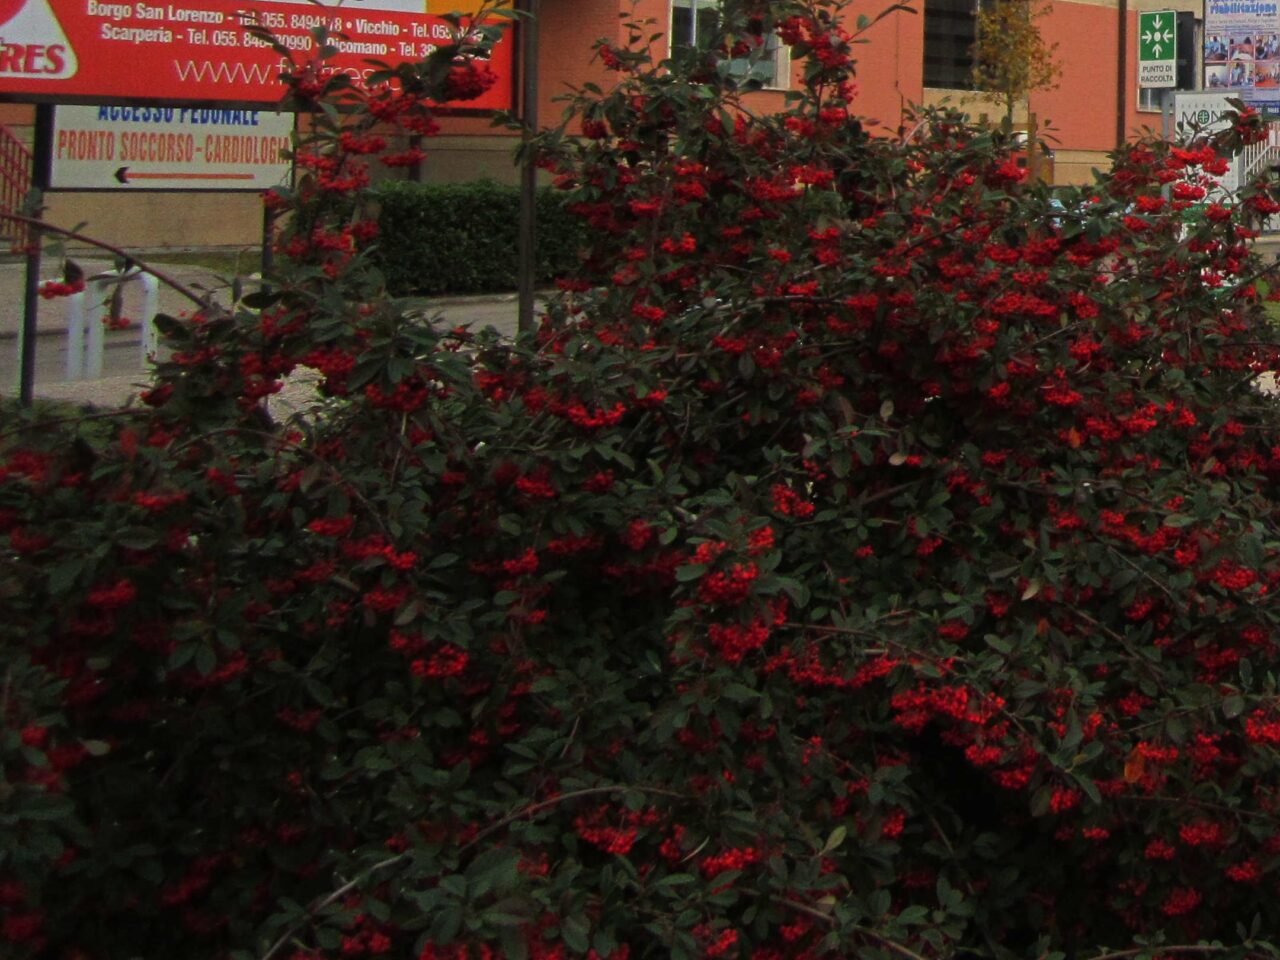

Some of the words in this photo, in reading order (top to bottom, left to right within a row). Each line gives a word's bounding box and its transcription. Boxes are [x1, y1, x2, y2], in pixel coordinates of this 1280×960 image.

[87, 0, 132, 21] Borgo
[136, 2, 164, 21] San
[168, 5, 224, 25] Lorenzo
[237, 9, 259, 27] Tel.
[356, 18, 400, 36] Vicchio
[411, 22, 430, 39] Tel.
[101, 23, 173, 45] Scarperia
[187, 28, 209, 45] Tel.
[212, 29, 240, 47] 055.
[399, 41, 418, 58] Tel.
[1140, 74, 1174, 83] RACCOLTA
[1142, 65, 1164, 73] PUNTO
[57, 129, 116, 161] PRONTO
